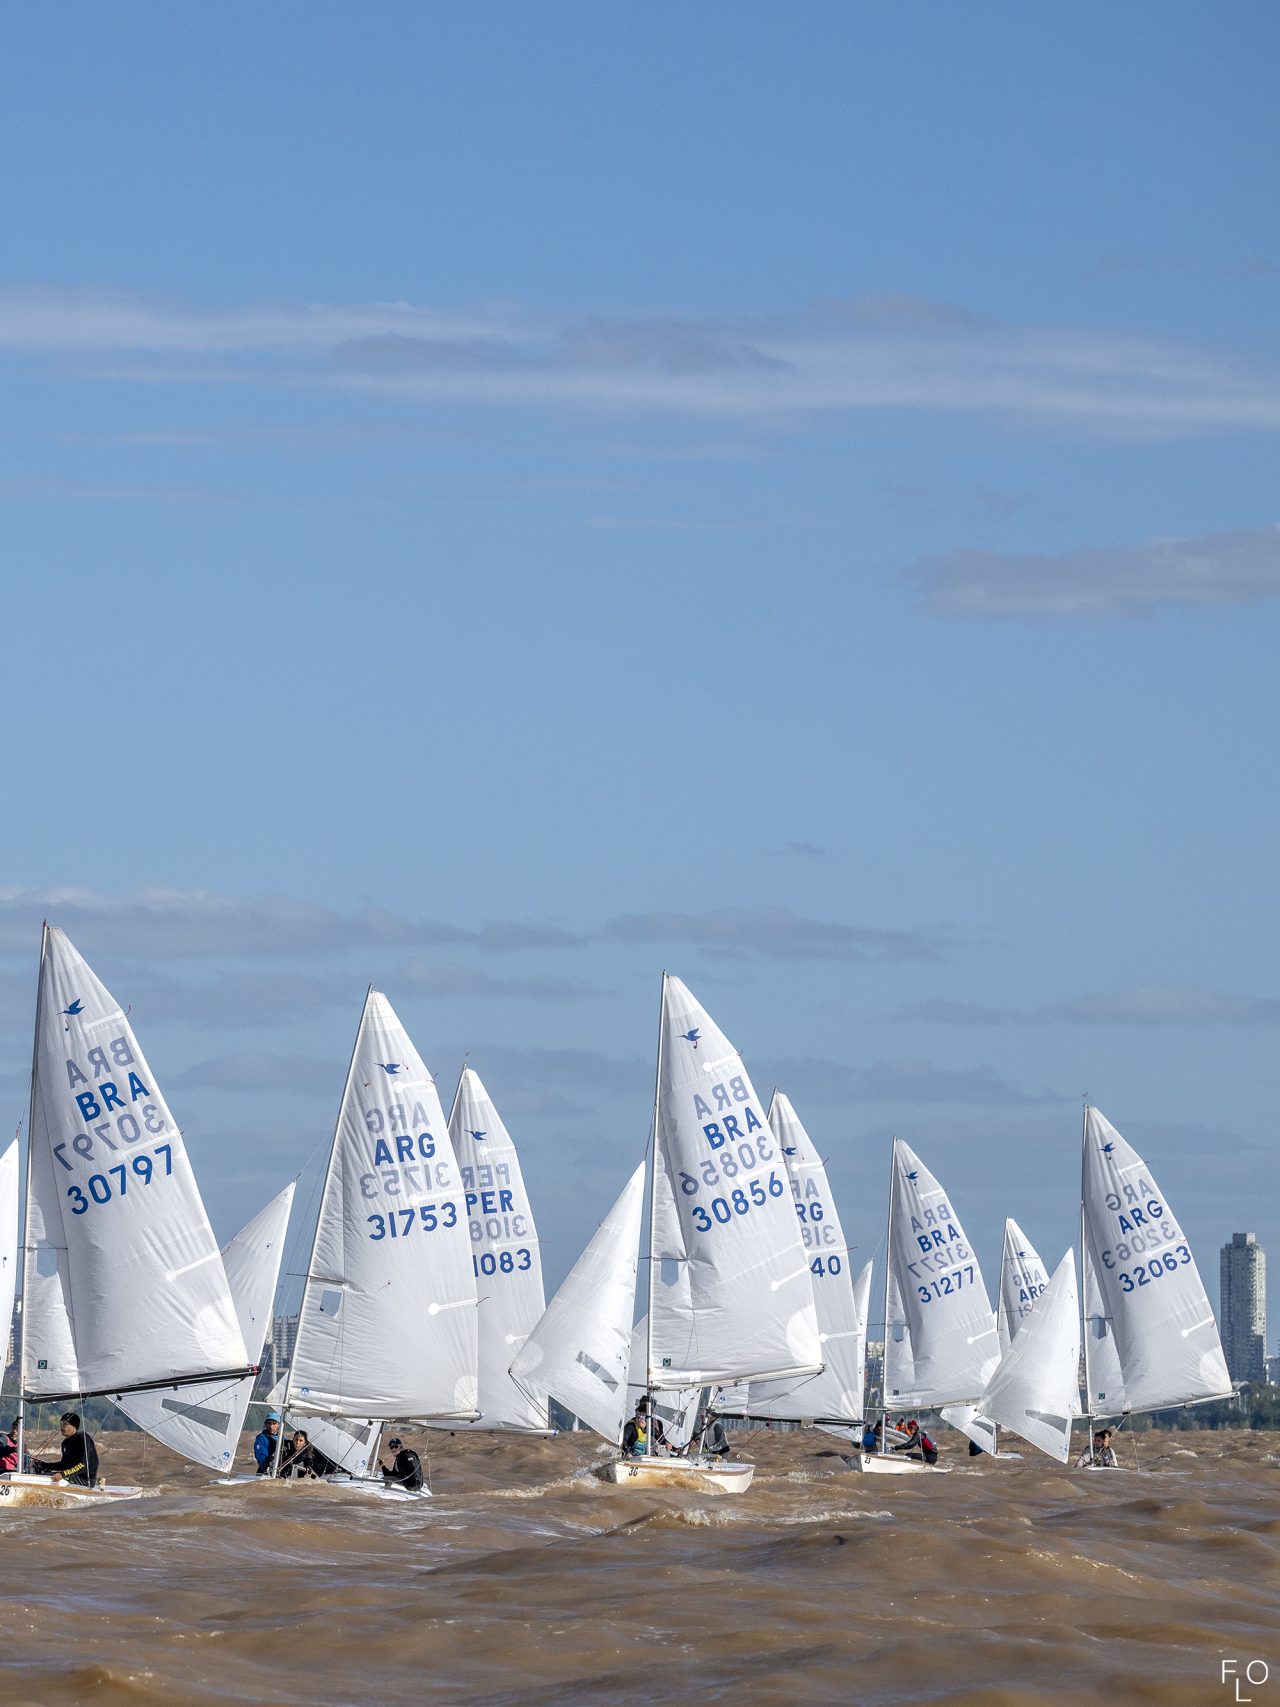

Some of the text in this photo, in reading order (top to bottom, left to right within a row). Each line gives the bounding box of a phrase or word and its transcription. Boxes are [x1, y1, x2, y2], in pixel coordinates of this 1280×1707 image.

[74, 1071, 150, 1122] BRA
[702, 1106, 763, 1150] BRA
[374, 1132, 436, 1166] ARG
[67, 1143, 172, 1215] 30797
[464, 1189, 514, 1216] PER
[691, 1171, 784, 1233] 30856
[795, 1201, 823, 1224] RG
[1118, 1199, 1163, 1235] ARG
[367, 1201, 458, 1241] 31753
[917, 1223, 960, 1253] BRA
[472, 1248, 532, 1277] 1083
[810, 1255, 841, 1278] 40
[1118, 1245, 1192, 1293] 32063
[918, 1266, 974, 1303] 31277
[0, 1484, 11, 1496] 26
